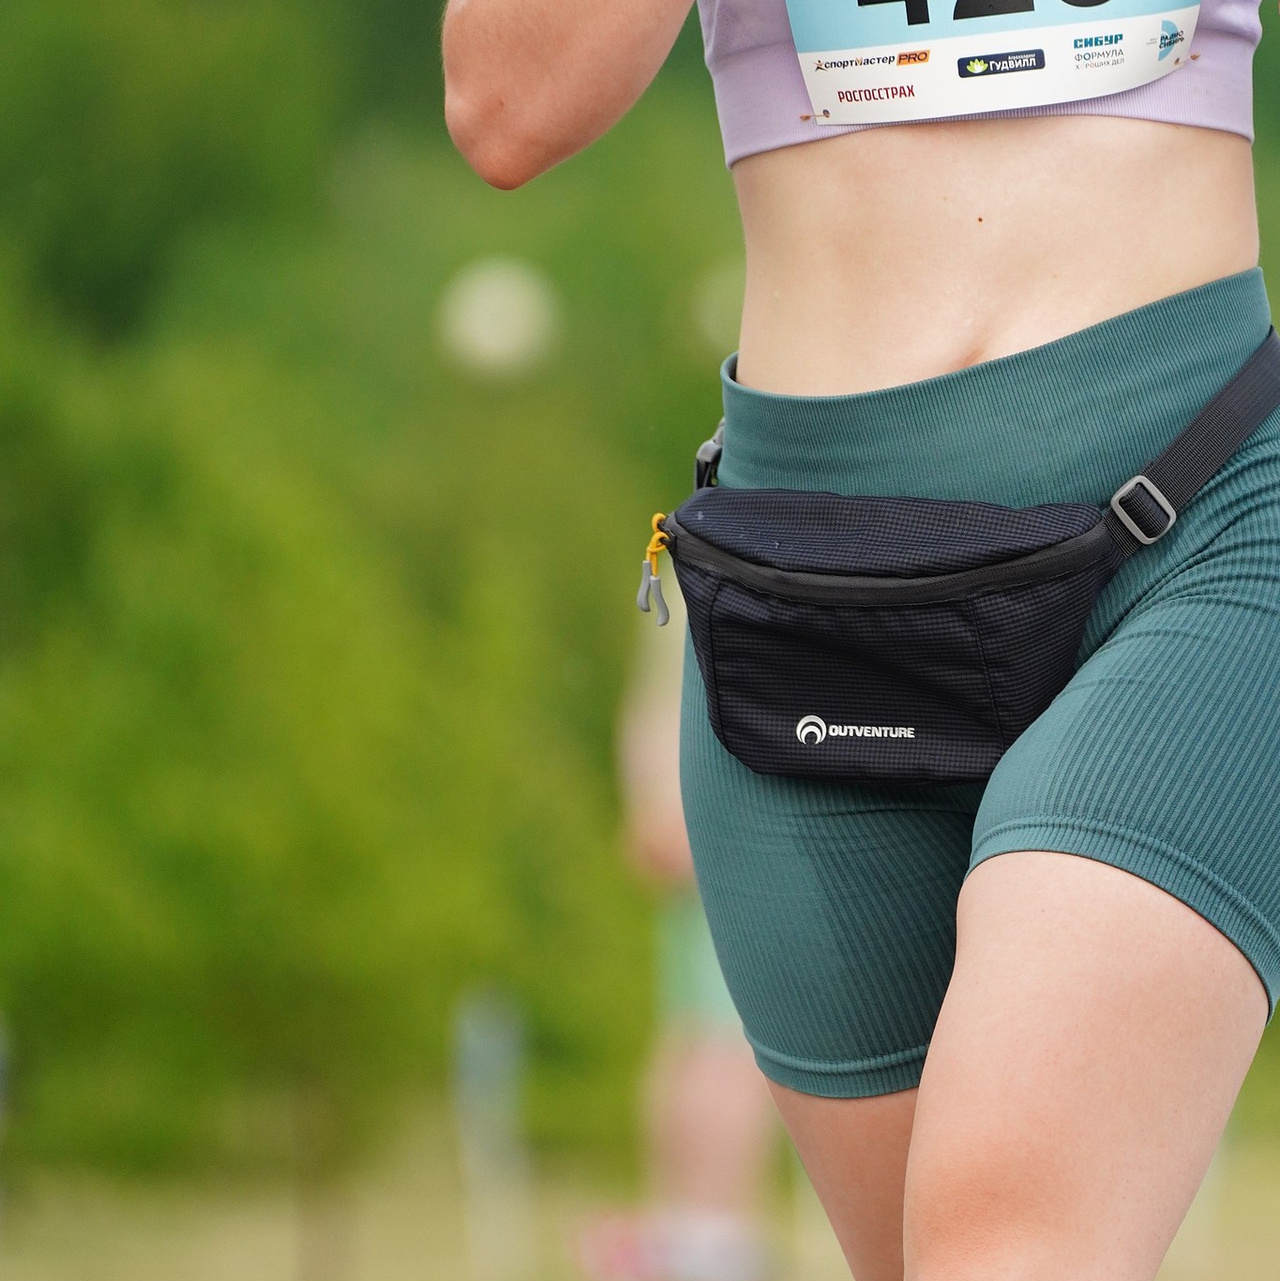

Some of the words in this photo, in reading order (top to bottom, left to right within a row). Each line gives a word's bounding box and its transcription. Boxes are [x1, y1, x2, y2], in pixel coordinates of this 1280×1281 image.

[1073, 33, 1124, 49] СИБУР
[897, 52, 929, 65] PRO
[1074, 49, 1124, 62] ФОРМУЛА
[990, 58, 1037, 71] ГУДВИЛЛ
[1075, 61, 1111, 70] ХОРОШИХ
[1111, 58, 1125, 66] ДЕЛ
[837, 85, 915, 103] РОСГОССТРАХ
[828, 724, 915, 738] OUTVENTURE
